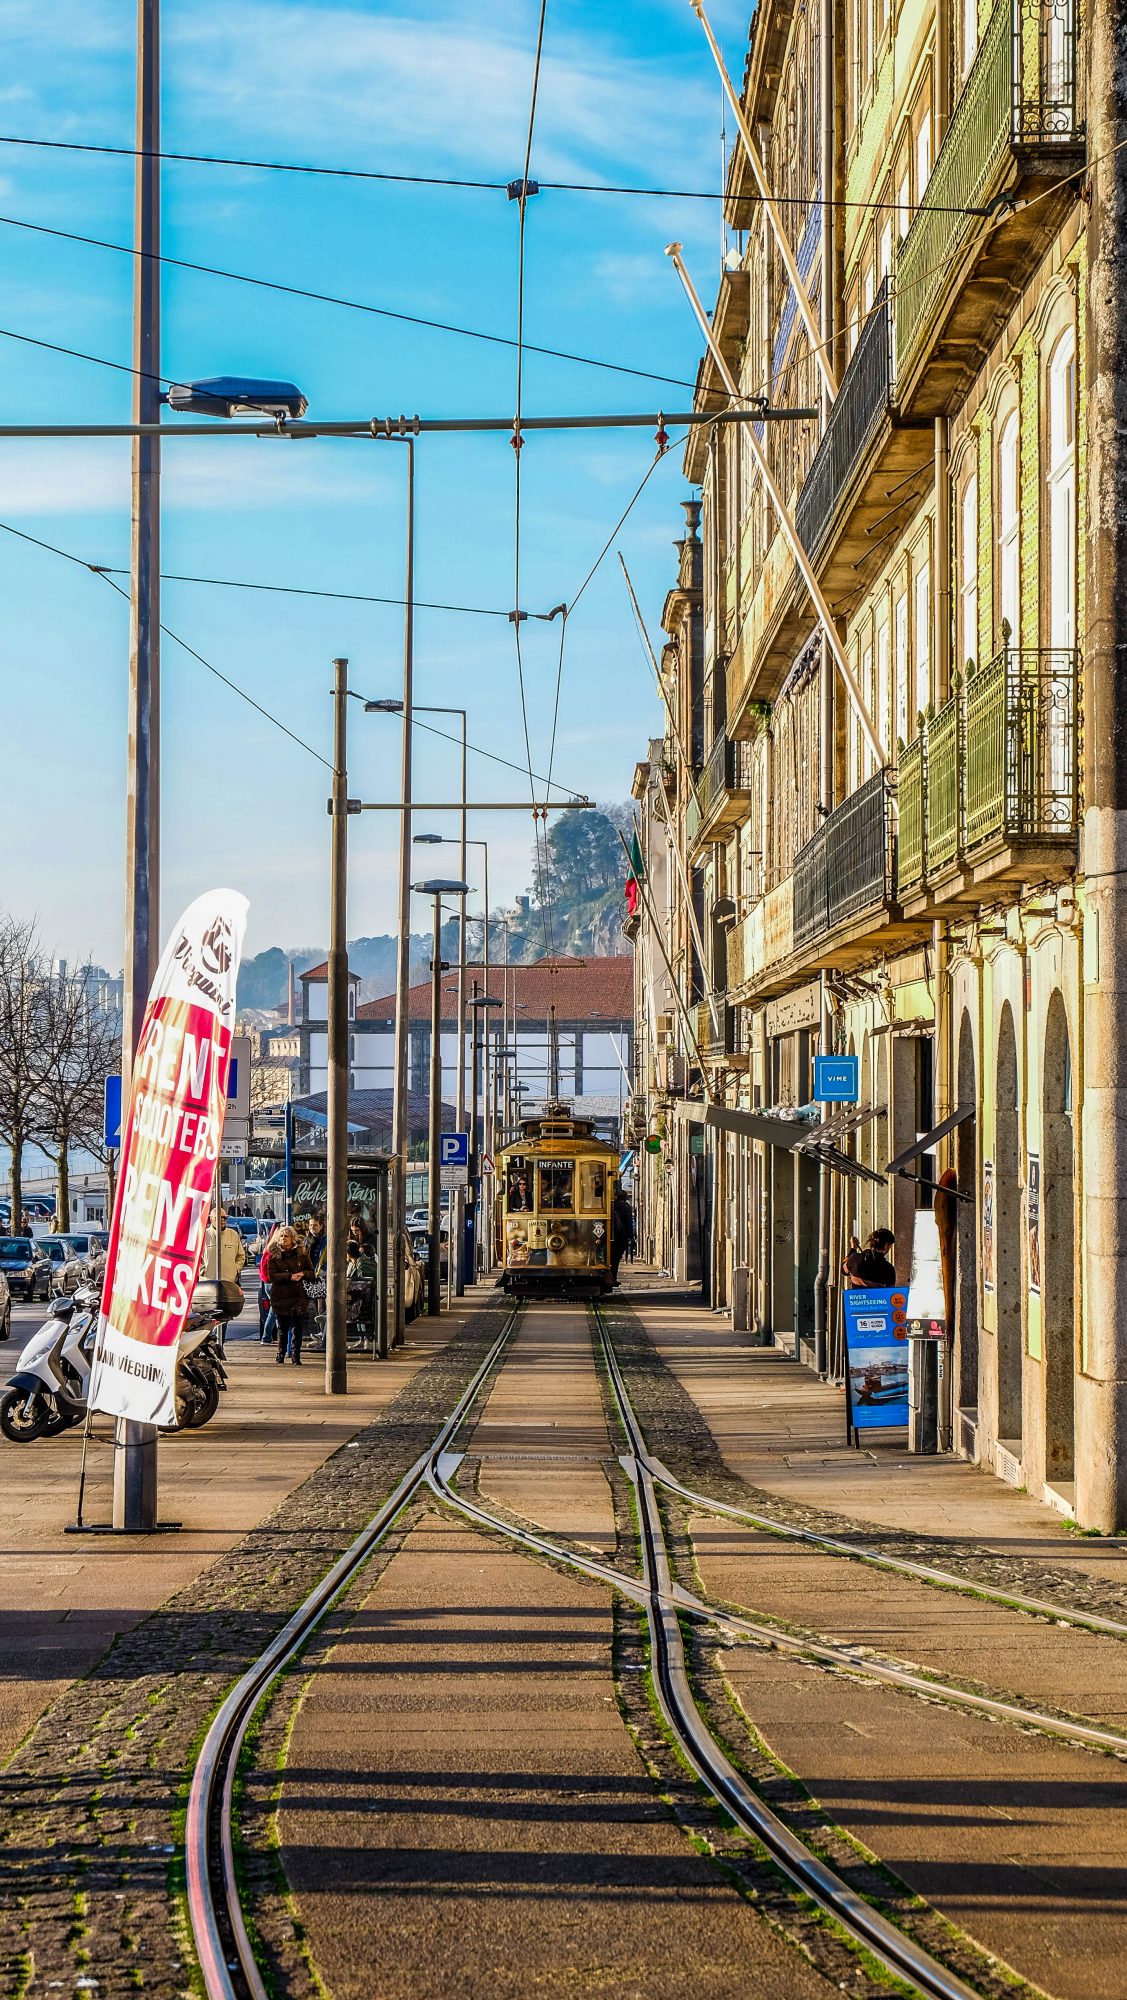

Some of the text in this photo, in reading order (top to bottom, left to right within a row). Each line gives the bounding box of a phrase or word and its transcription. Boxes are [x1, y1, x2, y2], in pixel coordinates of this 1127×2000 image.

[141, 1018, 226, 1108] RENT
[133, 1092, 219, 1161] SCOOTERS
[443, 1138, 460, 1161] P
[514, 1157, 520, 1167] 1
[538, 1161, 574, 1169] INFANTE
[120, 1163, 211, 1252] RENT
[292, 1213, 312, 1222] NOVA
[467, 1220, 473, 1228] P
